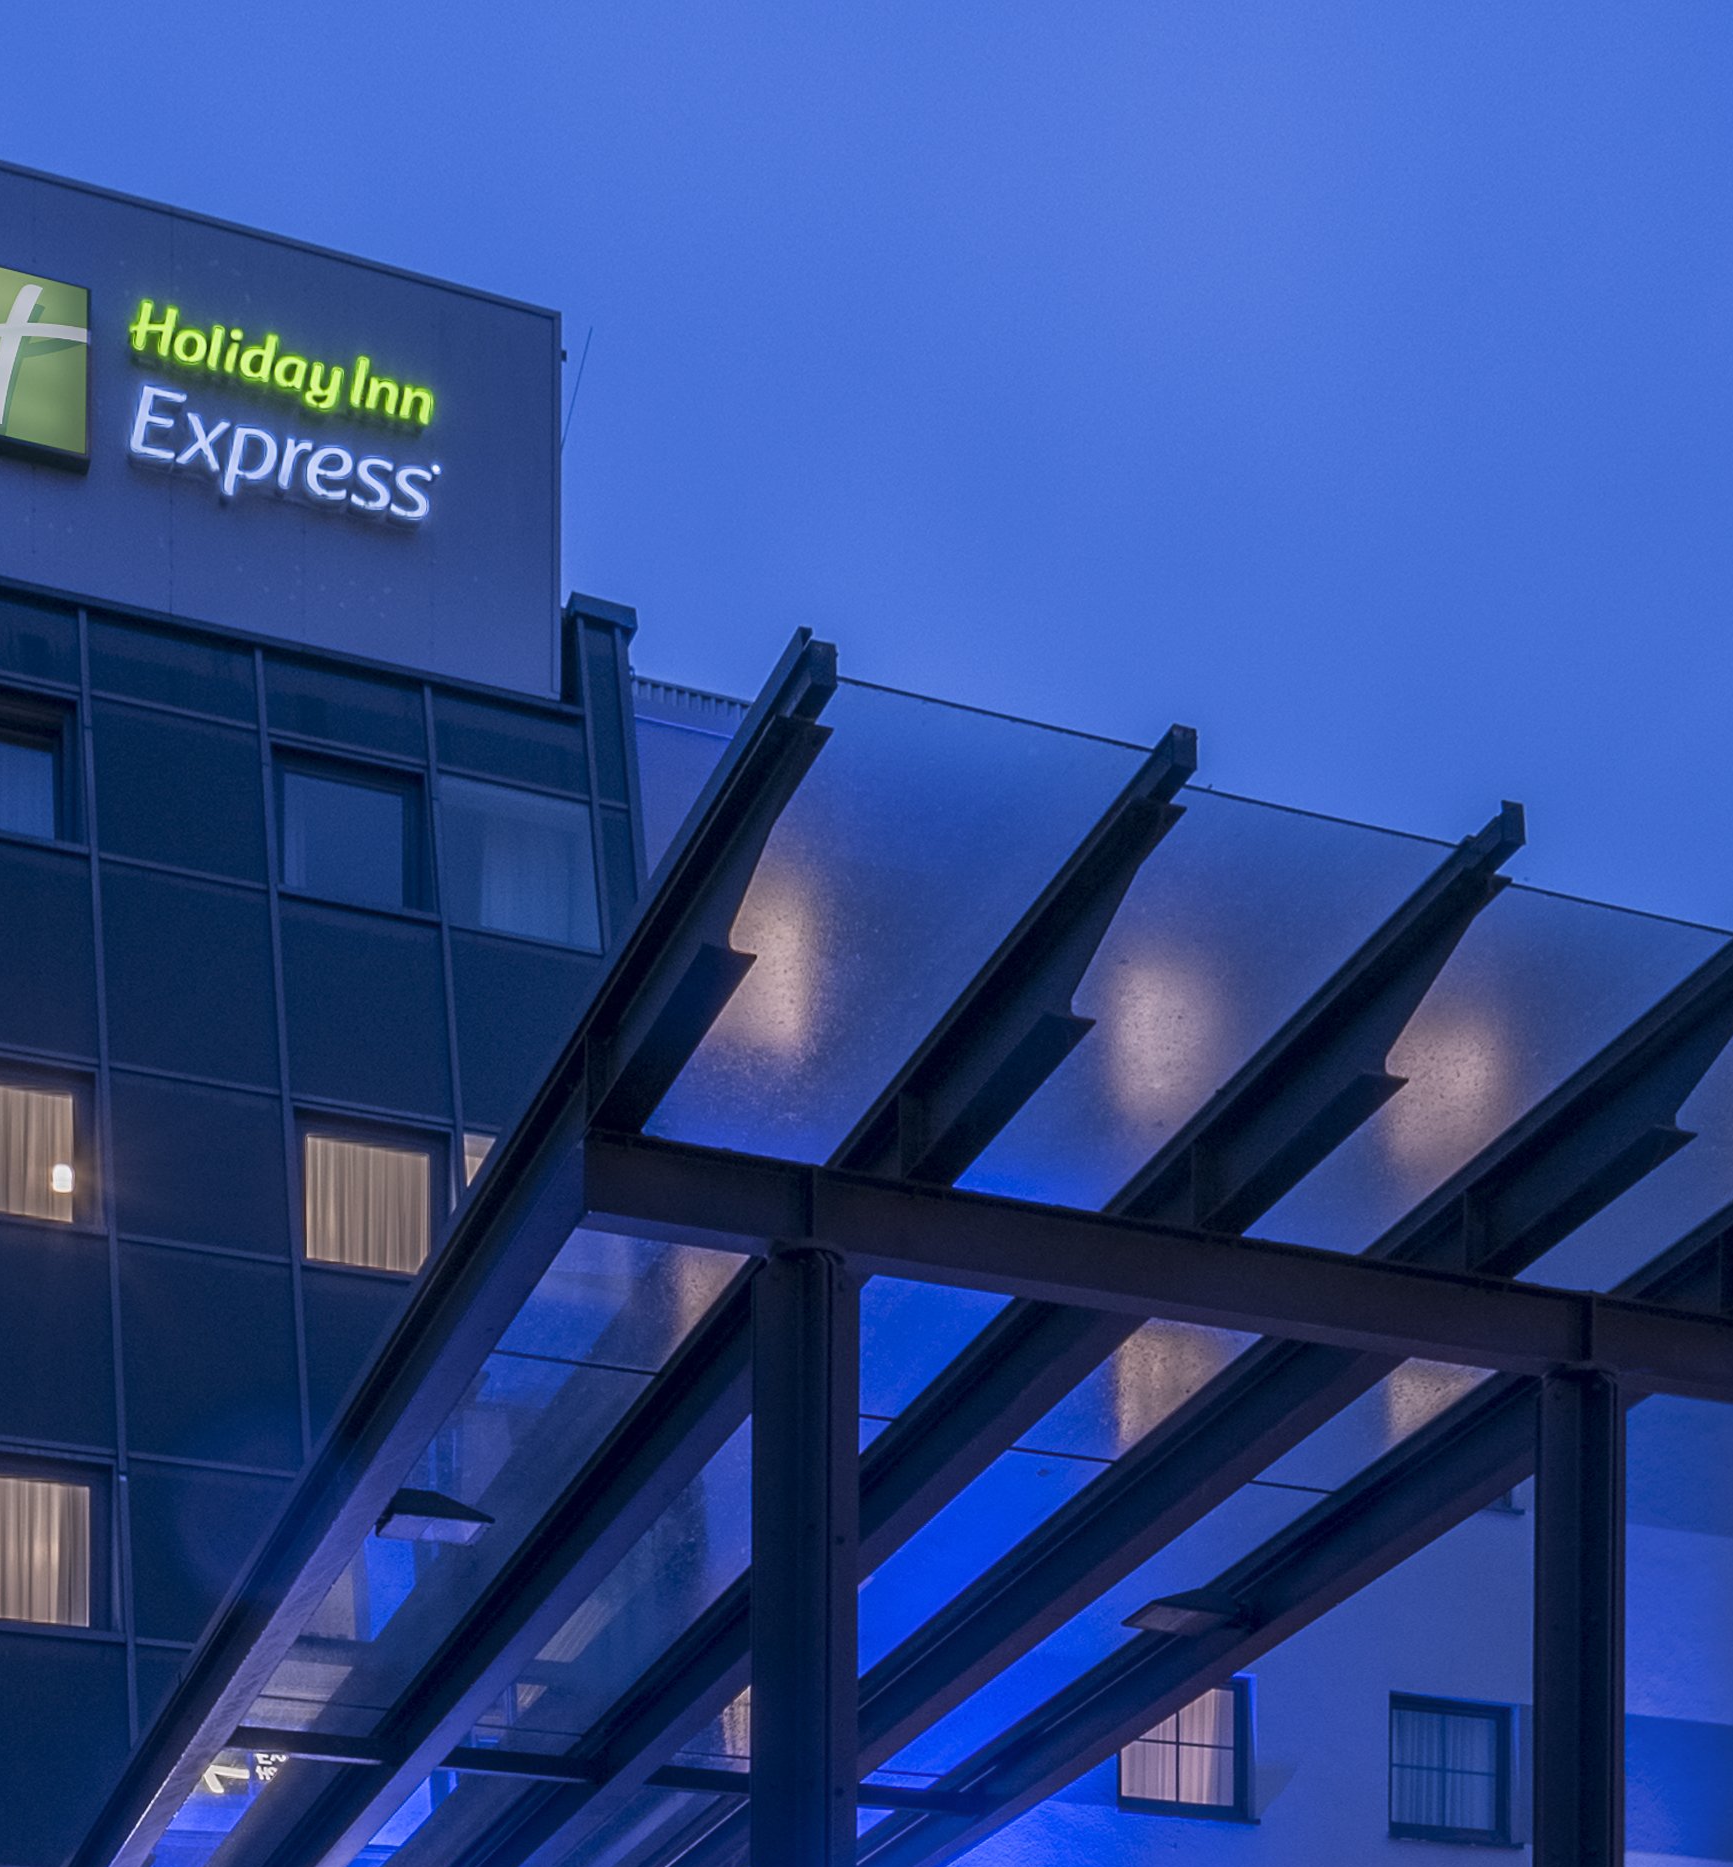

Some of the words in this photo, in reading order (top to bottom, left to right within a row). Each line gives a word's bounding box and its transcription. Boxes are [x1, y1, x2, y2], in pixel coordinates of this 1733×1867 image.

[129, 299, 345, 412] Holiday
[349, 355, 435, 425] Inn
[129, 384, 433, 520] Express
